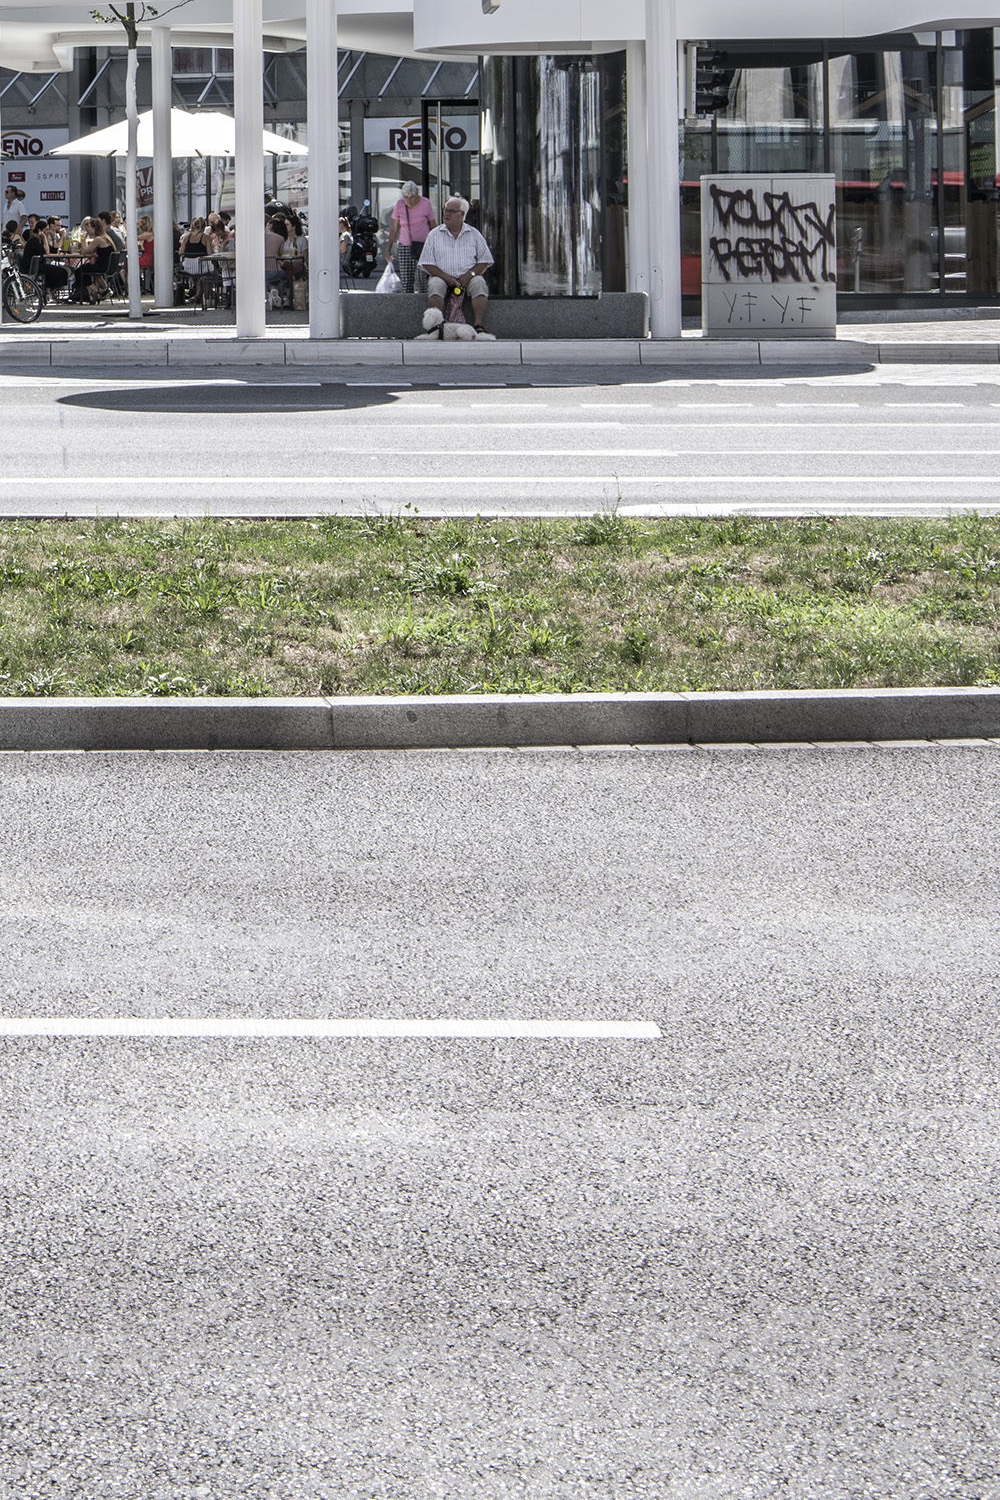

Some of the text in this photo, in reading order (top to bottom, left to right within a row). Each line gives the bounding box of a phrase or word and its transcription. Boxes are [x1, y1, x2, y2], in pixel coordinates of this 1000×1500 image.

[1, 138, 44, 156] ENO
[390, 127, 467, 150] RENO
[37, 172, 69, 180] ESPRIT
